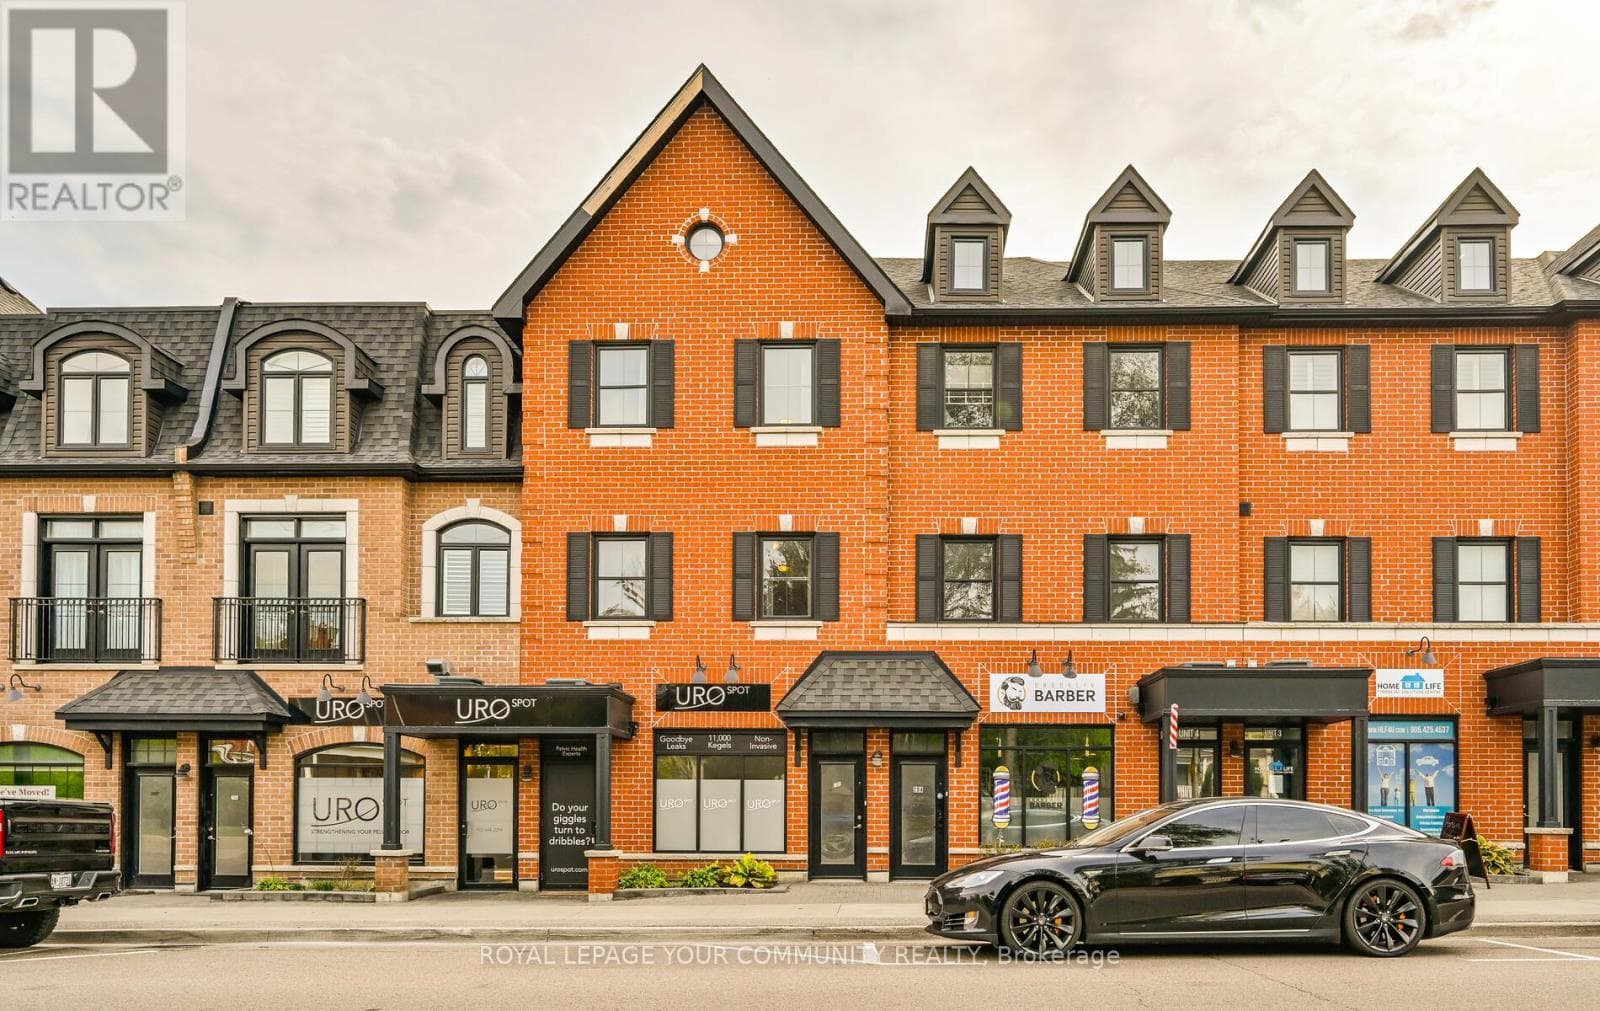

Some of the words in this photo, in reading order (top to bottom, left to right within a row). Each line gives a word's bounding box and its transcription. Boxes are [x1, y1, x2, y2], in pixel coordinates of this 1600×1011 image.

[1377, 682, 1401, 690] HOME
[1425, 682, 1443, 690] LIFE
[672, 686, 726, 710] URO
[727, 686, 751, 695] SPOT
[1034, 689, 1097, 702] BARBER
[314, 700, 365, 723] URO
[455, 698, 511, 724] URO
[511, 698, 538, 708] SPOT
[1178, 728, 1195, 738] UNIT
[1196, 729, 1201, 737] 4
[1264, 728, 1277, 738] UNIT
[1277, 729, 1283, 737] 3
[659, 736, 694, 744] Goodbye
[708, 734, 732, 743] 11,000
[754, 735, 774, 743] Non-
[666, 742, 687, 750] Leaks
[707, 741, 733, 751] Kegels
[749, 742, 778, 750] Invasive
[0, 787, 19, 796] e've
[19, 786, 51, 796] Moved!
[471, 799, 498, 812] URO
[552, 802, 566, 812] Do
[567, 804, 589, 815] your
[659, 799, 685, 810] URO
[703, 799, 728, 810] URO
[747, 799, 773, 810] URO
[312, 797, 380, 827] URO
[553, 814, 587, 825] giggles
[554, 825, 573, 834] turn
[574, 825, 586, 834] to
[549, 836, 591, 846] dribbles?
[550, 866, 589, 874] urospot.com
